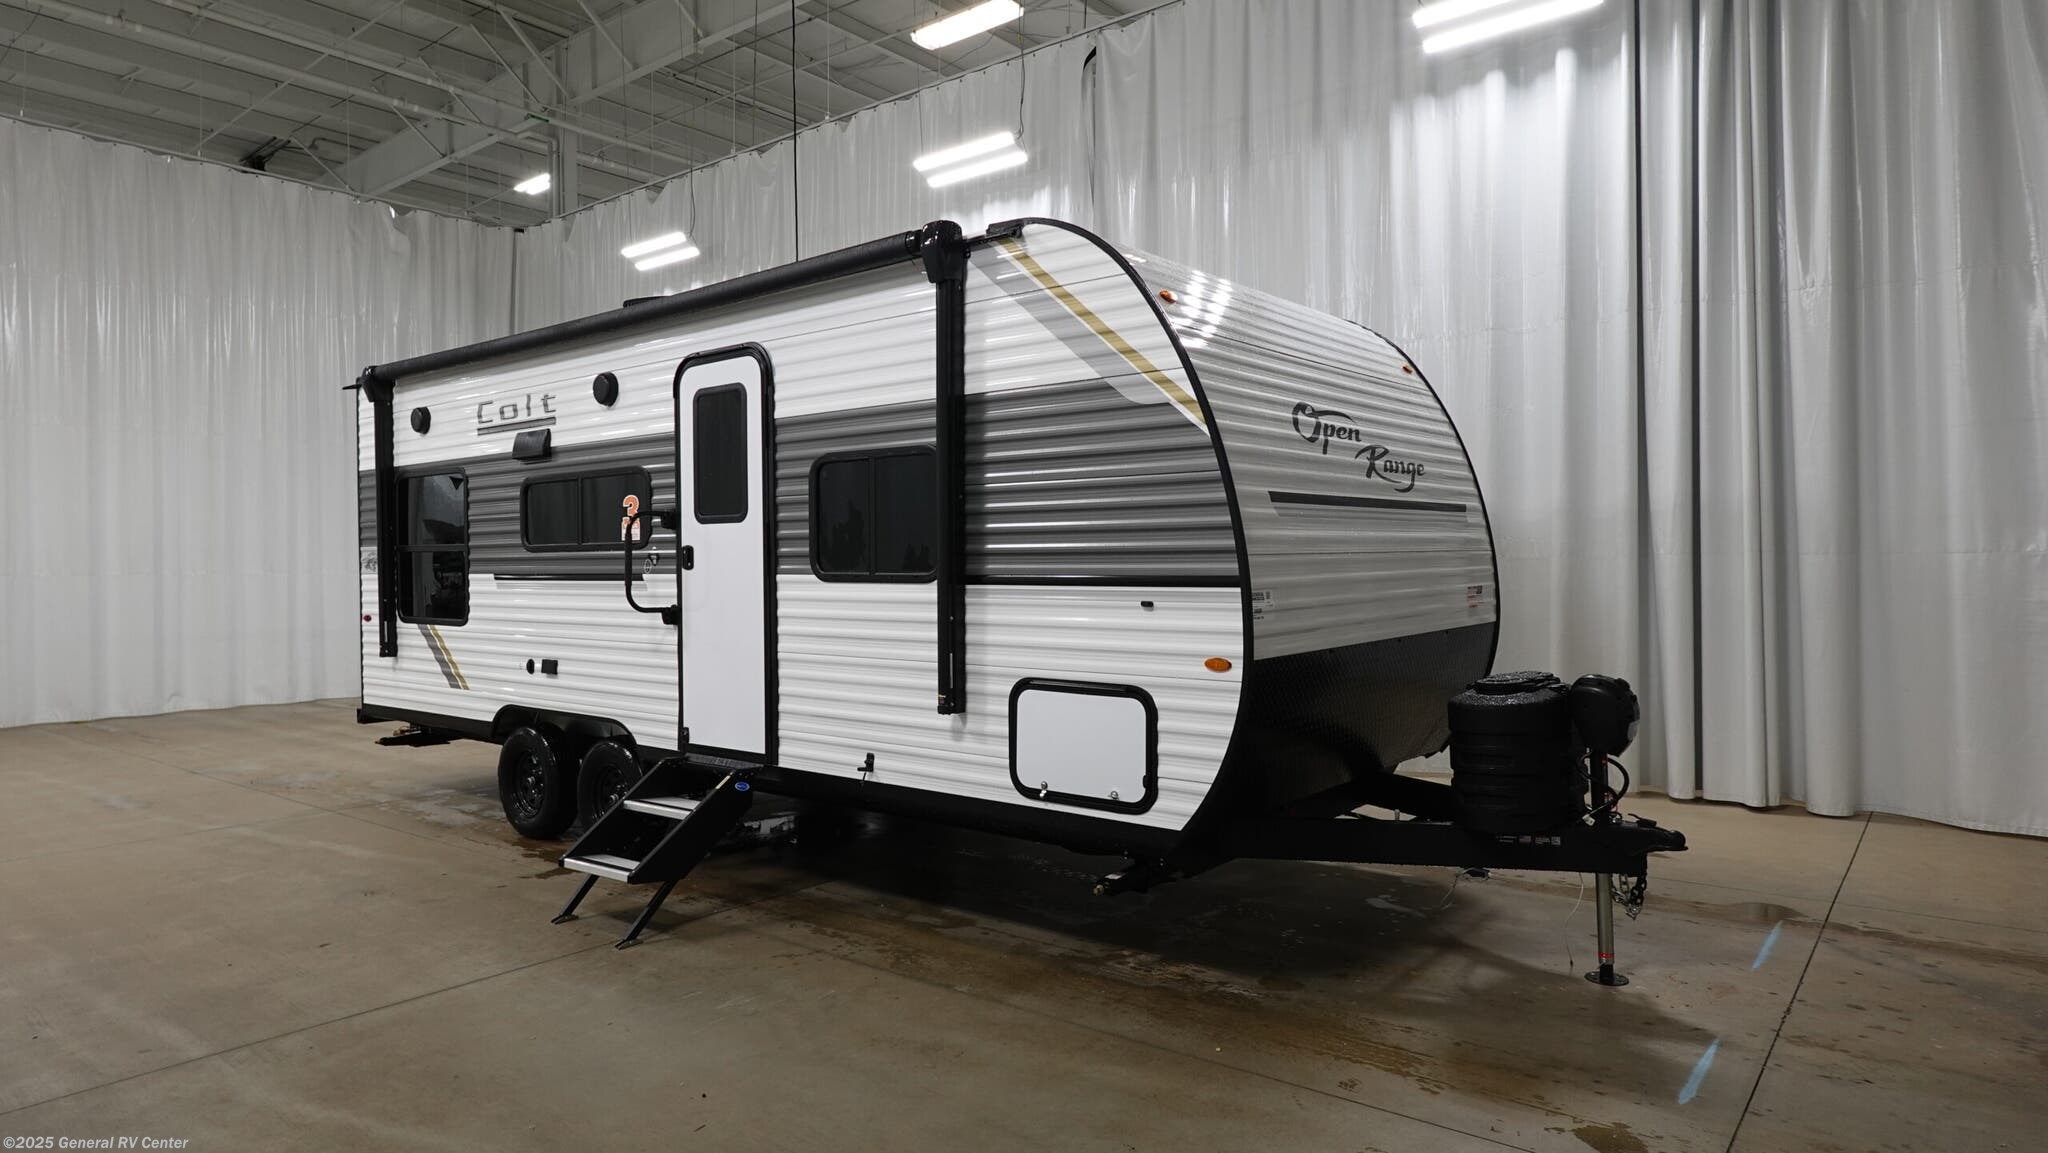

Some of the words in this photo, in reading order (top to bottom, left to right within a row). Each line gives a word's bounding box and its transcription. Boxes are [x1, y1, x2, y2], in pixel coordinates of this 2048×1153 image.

[477, 393, 556, 424] Colt
[1292, 401, 1362, 455] Open
[1355, 444, 1426, 493] Range
